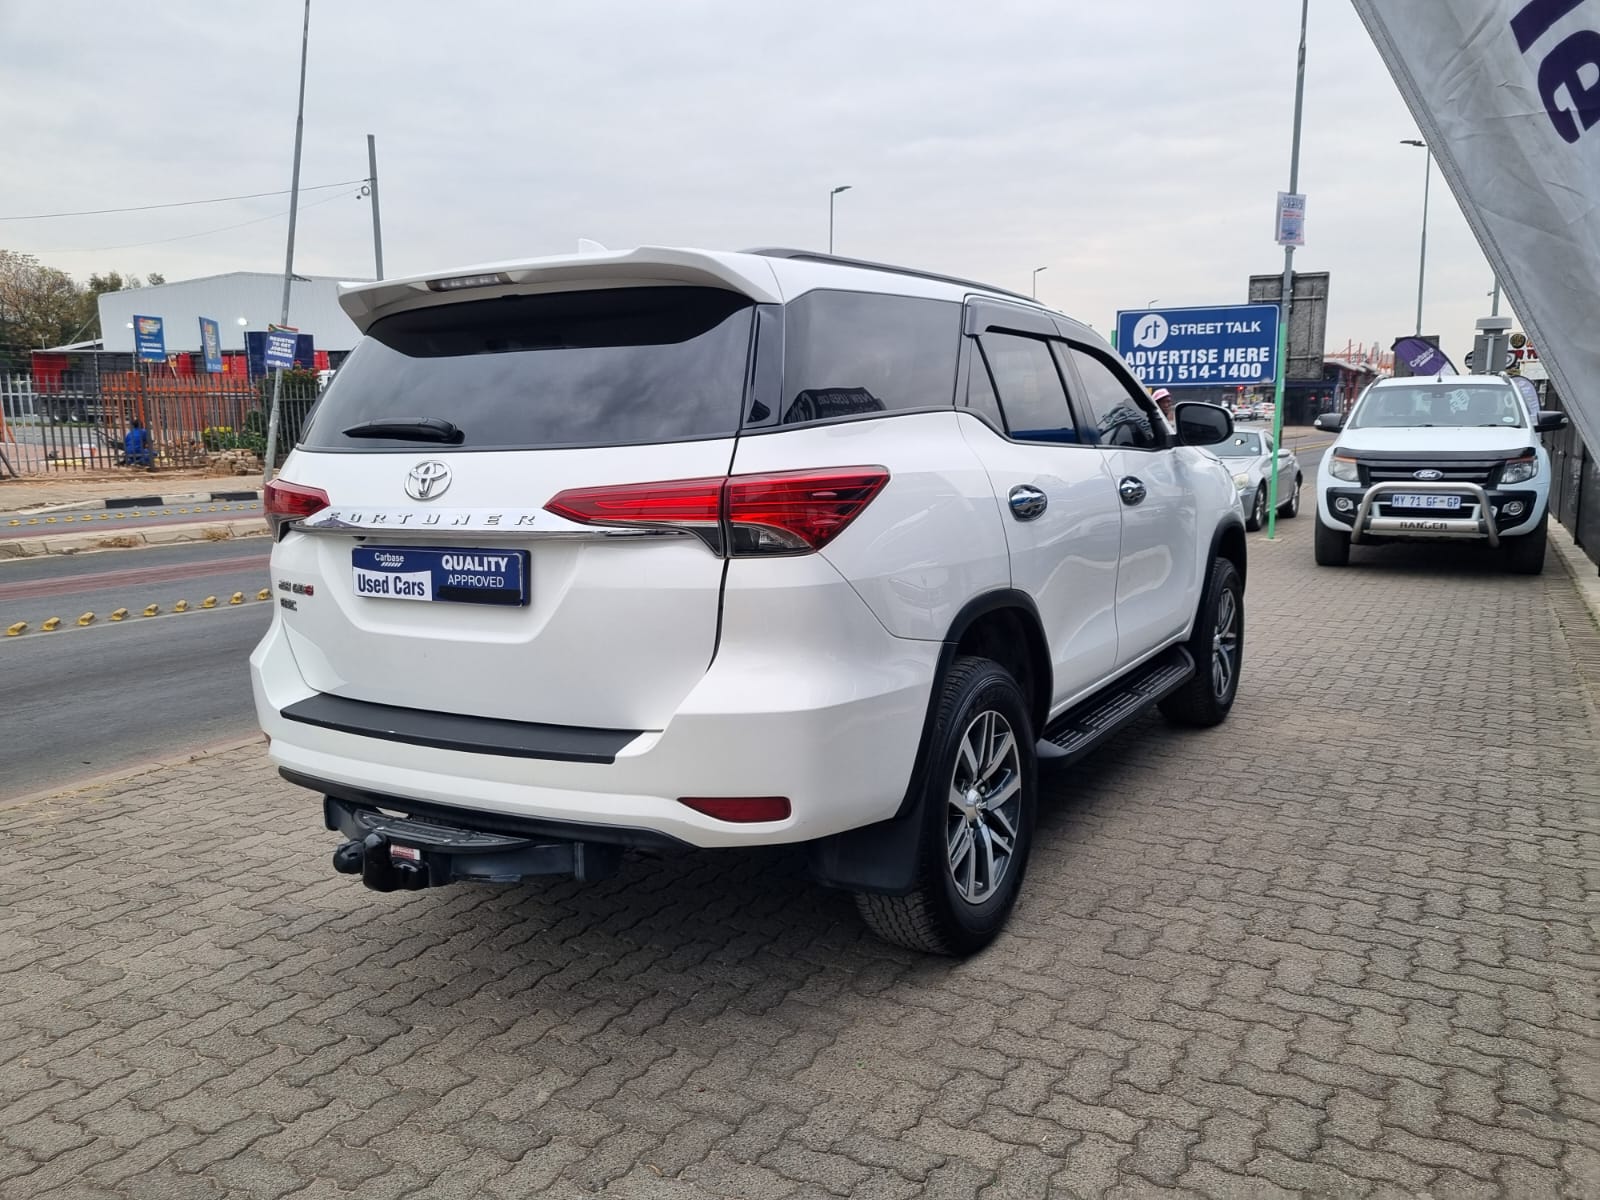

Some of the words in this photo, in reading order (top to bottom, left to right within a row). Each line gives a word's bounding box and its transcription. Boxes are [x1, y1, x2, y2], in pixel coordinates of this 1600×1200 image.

[1170, 323, 1223, 336] STREET
[1224, 321, 1261, 334] TALK
[1125, 348, 1218, 366] ADVERTISE
[1223, 347, 1270, 363] HERE
[1178, 363, 1262, 379] 514-1400
[1410, 496, 1421, 506] 71
[1447, 497, 1459, 508] GP
[328, 511, 536, 526] FORTUNER
[1399, 521, 1448, 530] RANGER
[374, 552, 404, 563] Carbase
[441, 554, 509, 573] QUALITY
[357, 574, 389, 595] Used
[393, 575, 425, 597] Cars
[447, 574, 504, 588] APPROVED
